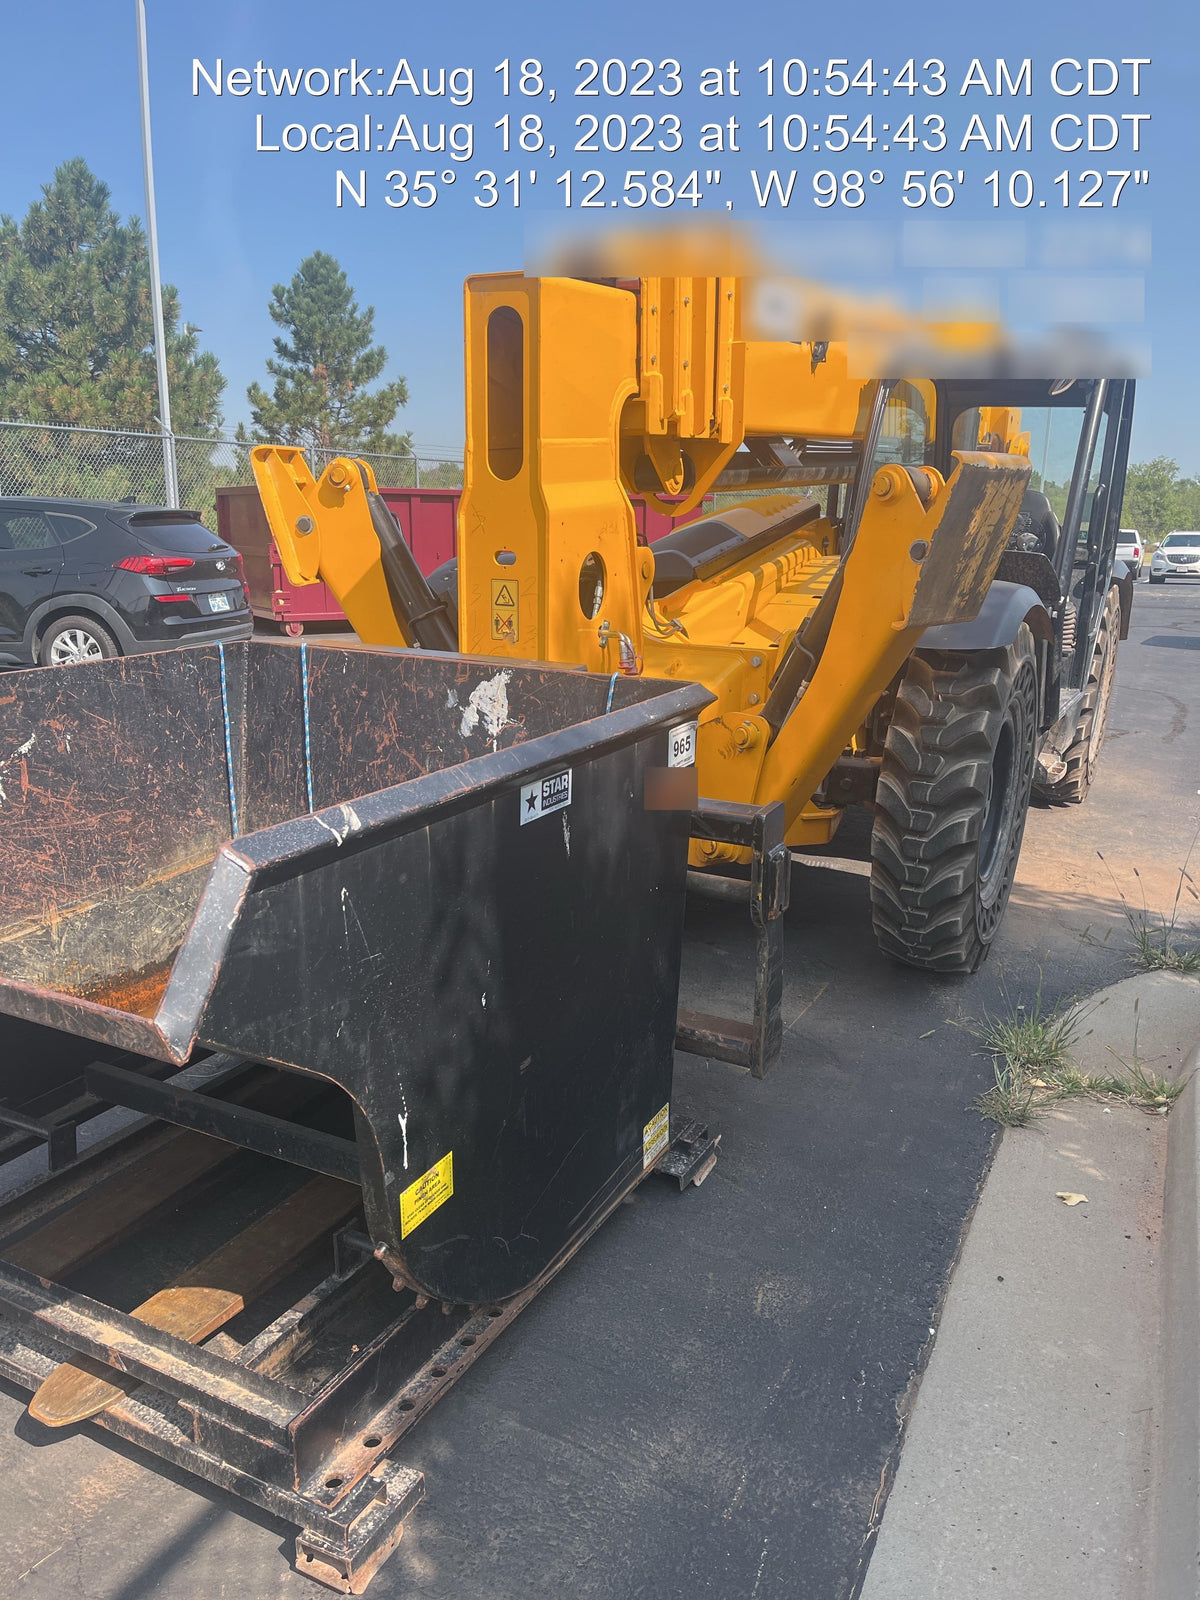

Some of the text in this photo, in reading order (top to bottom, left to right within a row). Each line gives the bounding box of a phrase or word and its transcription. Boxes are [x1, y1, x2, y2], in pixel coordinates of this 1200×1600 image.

[673, 735, 691, 758] 965
[542, 774, 569, 797] STAR
[542, 791, 569, 807] INDUSTRIES
[415, 1171, 440, 1196] CAUTION
